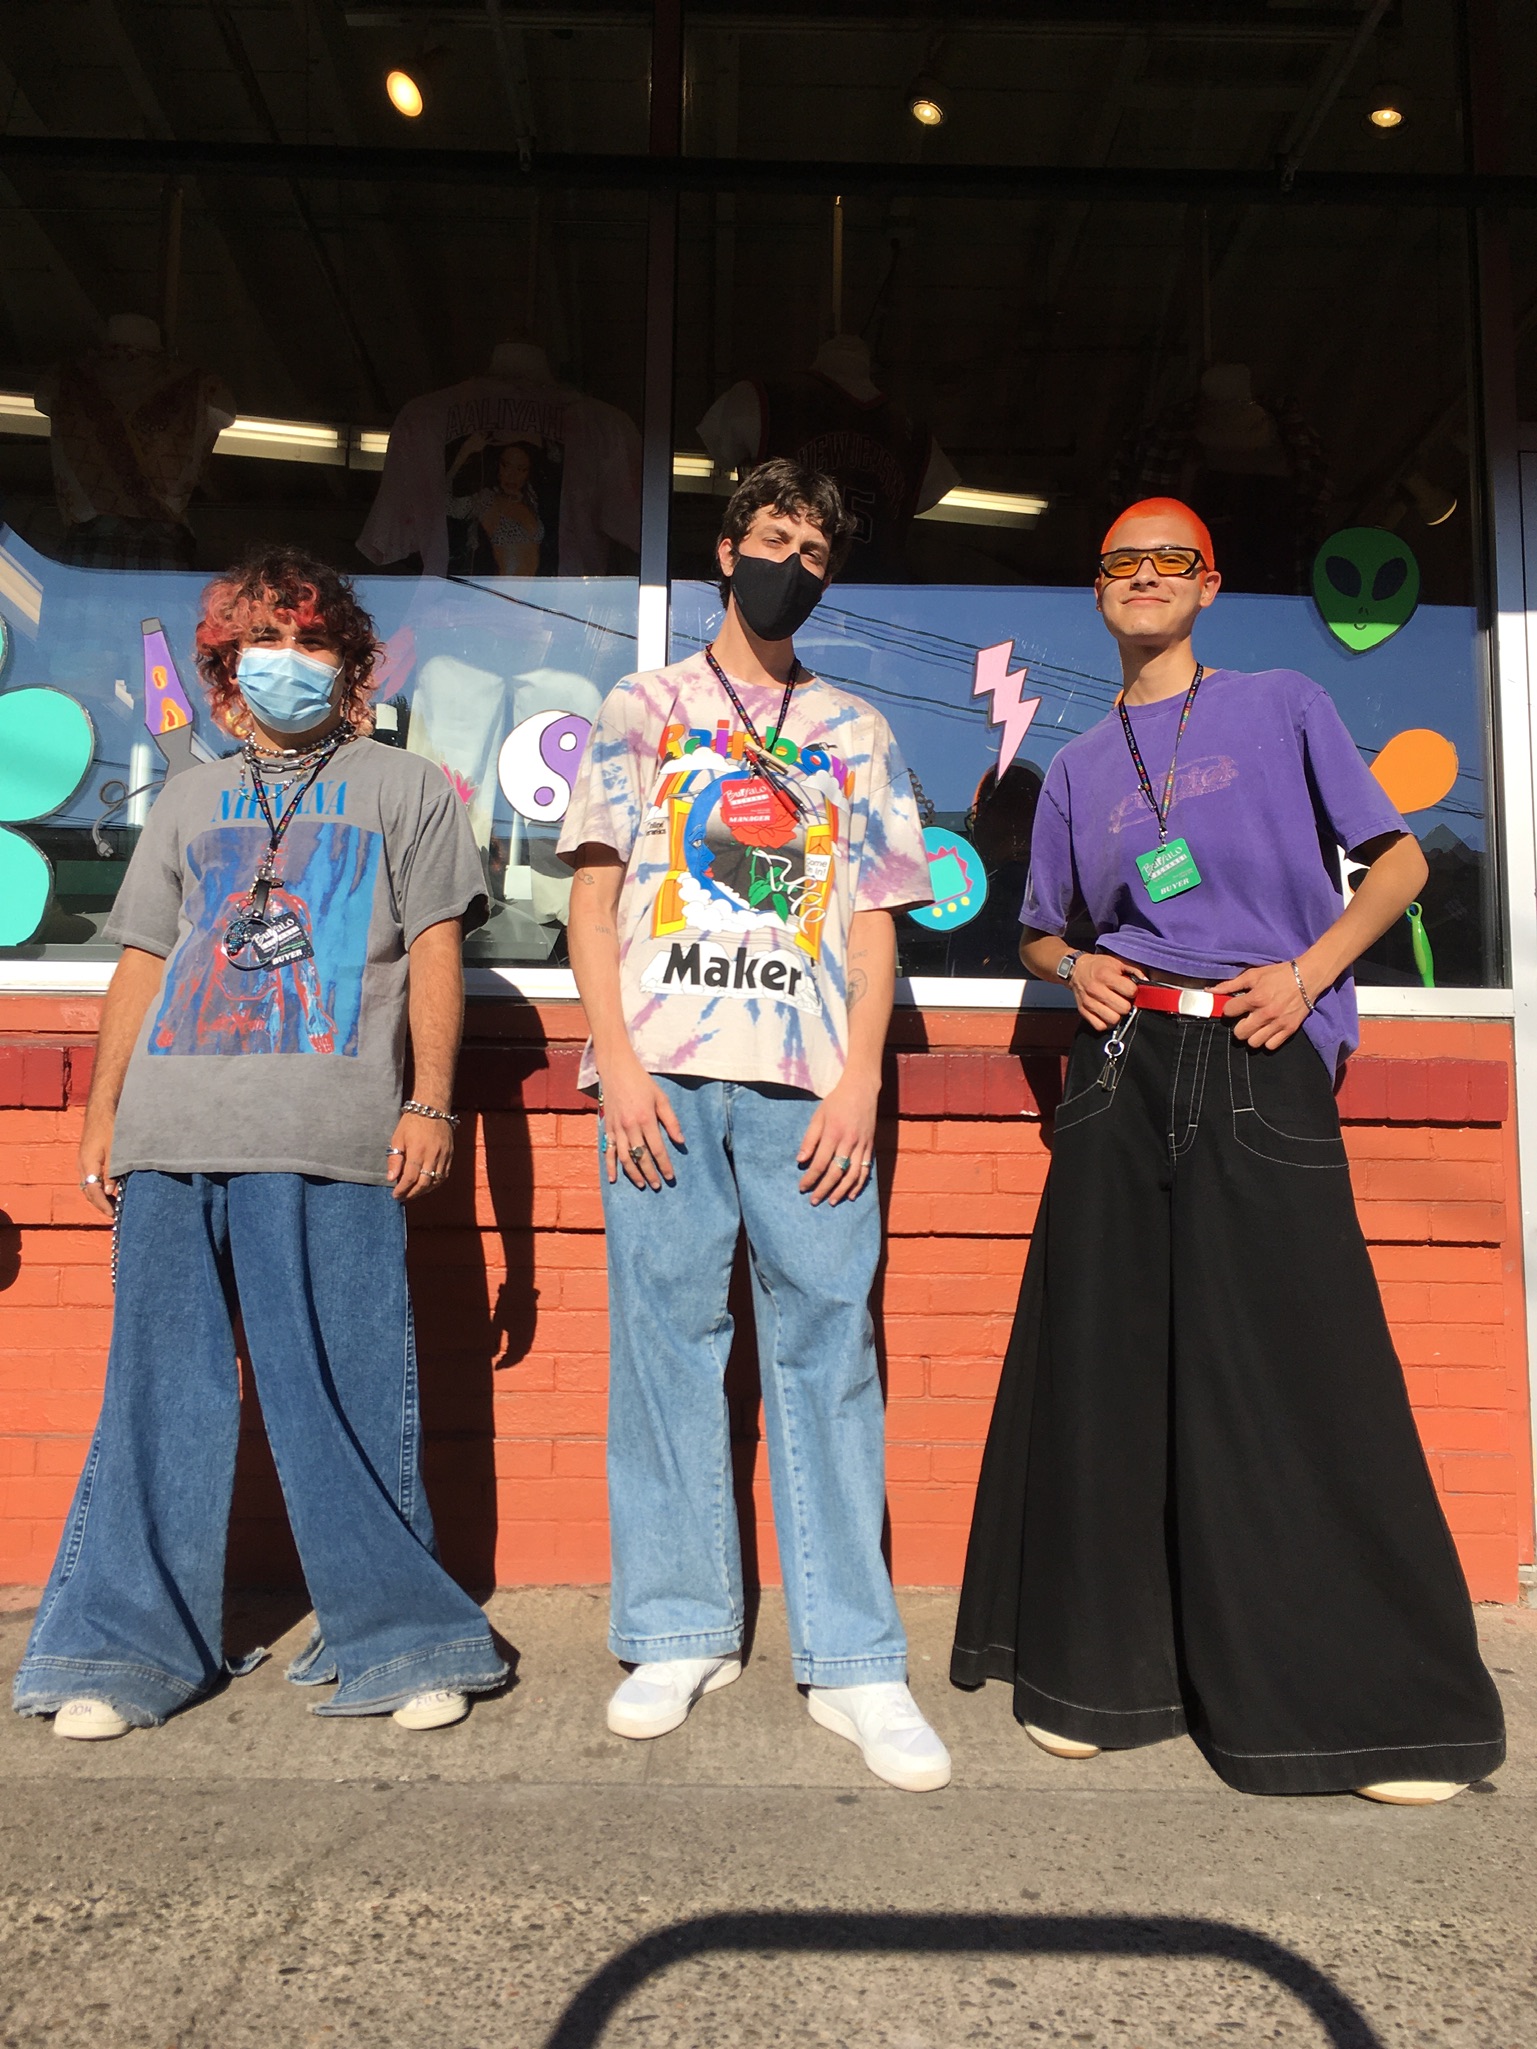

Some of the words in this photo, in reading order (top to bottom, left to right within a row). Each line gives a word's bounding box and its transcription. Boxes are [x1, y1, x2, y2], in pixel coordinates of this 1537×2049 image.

[446, 398, 568, 440] AALIYAH
[728, 815, 771, 823] MANAGER
[1160, 877, 1190, 895] BUYER
[272, 949, 303, 966] BUYER
[662, 942, 804, 997] Maker
